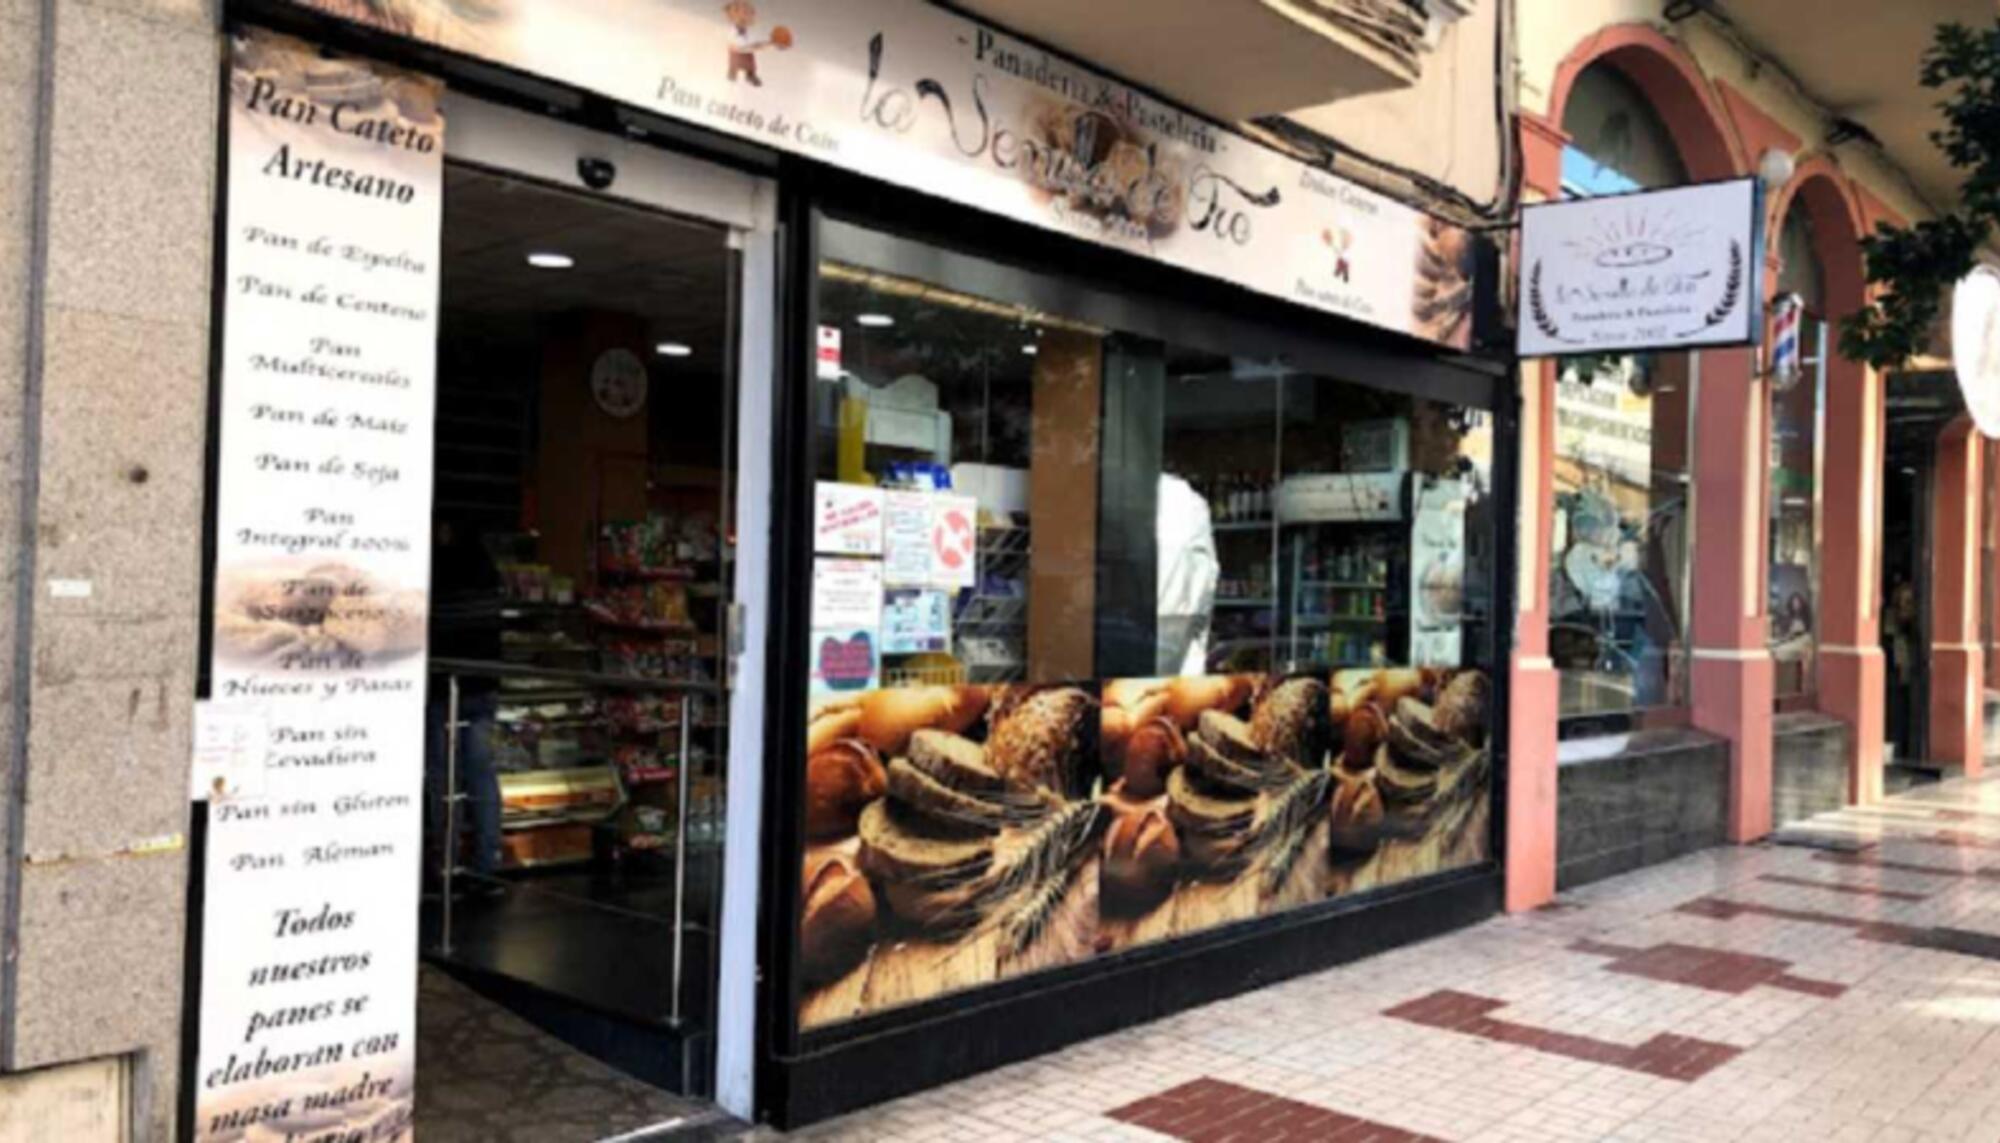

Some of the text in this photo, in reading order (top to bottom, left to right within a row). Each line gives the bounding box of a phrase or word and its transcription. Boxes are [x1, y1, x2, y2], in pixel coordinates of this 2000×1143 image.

[246, 76, 435, 154] Pan Cateto
[657, 75, 702, 109] Pan
[767, 114, 791, 137] de
[262, 144, 415, 205] Artesano
[243, 226, 299, 251] Pan
[306, 237, 333, 258] de
[237, 275, 292, 300] Pan
[300, 284, 328, 305] de
[310, 337, 362, 358] Pan
[249, 404, 304, 423] Pan
[312, 410, 338, 428] de
[254, 453, 401, 489] Pan de Soja
[303, 507, 354, 526] Pan
[236, 529, 346, 553] Integral
[281, 579, 368, 598] Pan de
[279, 652, 331, 671] Pan
[223, 675, 414, 700] Nueces y Pasas
[270, 725, 368, 744] Pan sin
[216, 792, 410, 822] Pan sin Gluten
[229, 852, 285, 871] Pan
[273, 902, 356, 938] Todos
[248, 950, 372, 987] nuestros
[244, 994, 369, 1043] panes se
[205, 1031, 400, 1090] elaboran con
[209, 1097, 293, 1135] masa
[303, 1071, 395, 1113] madre
